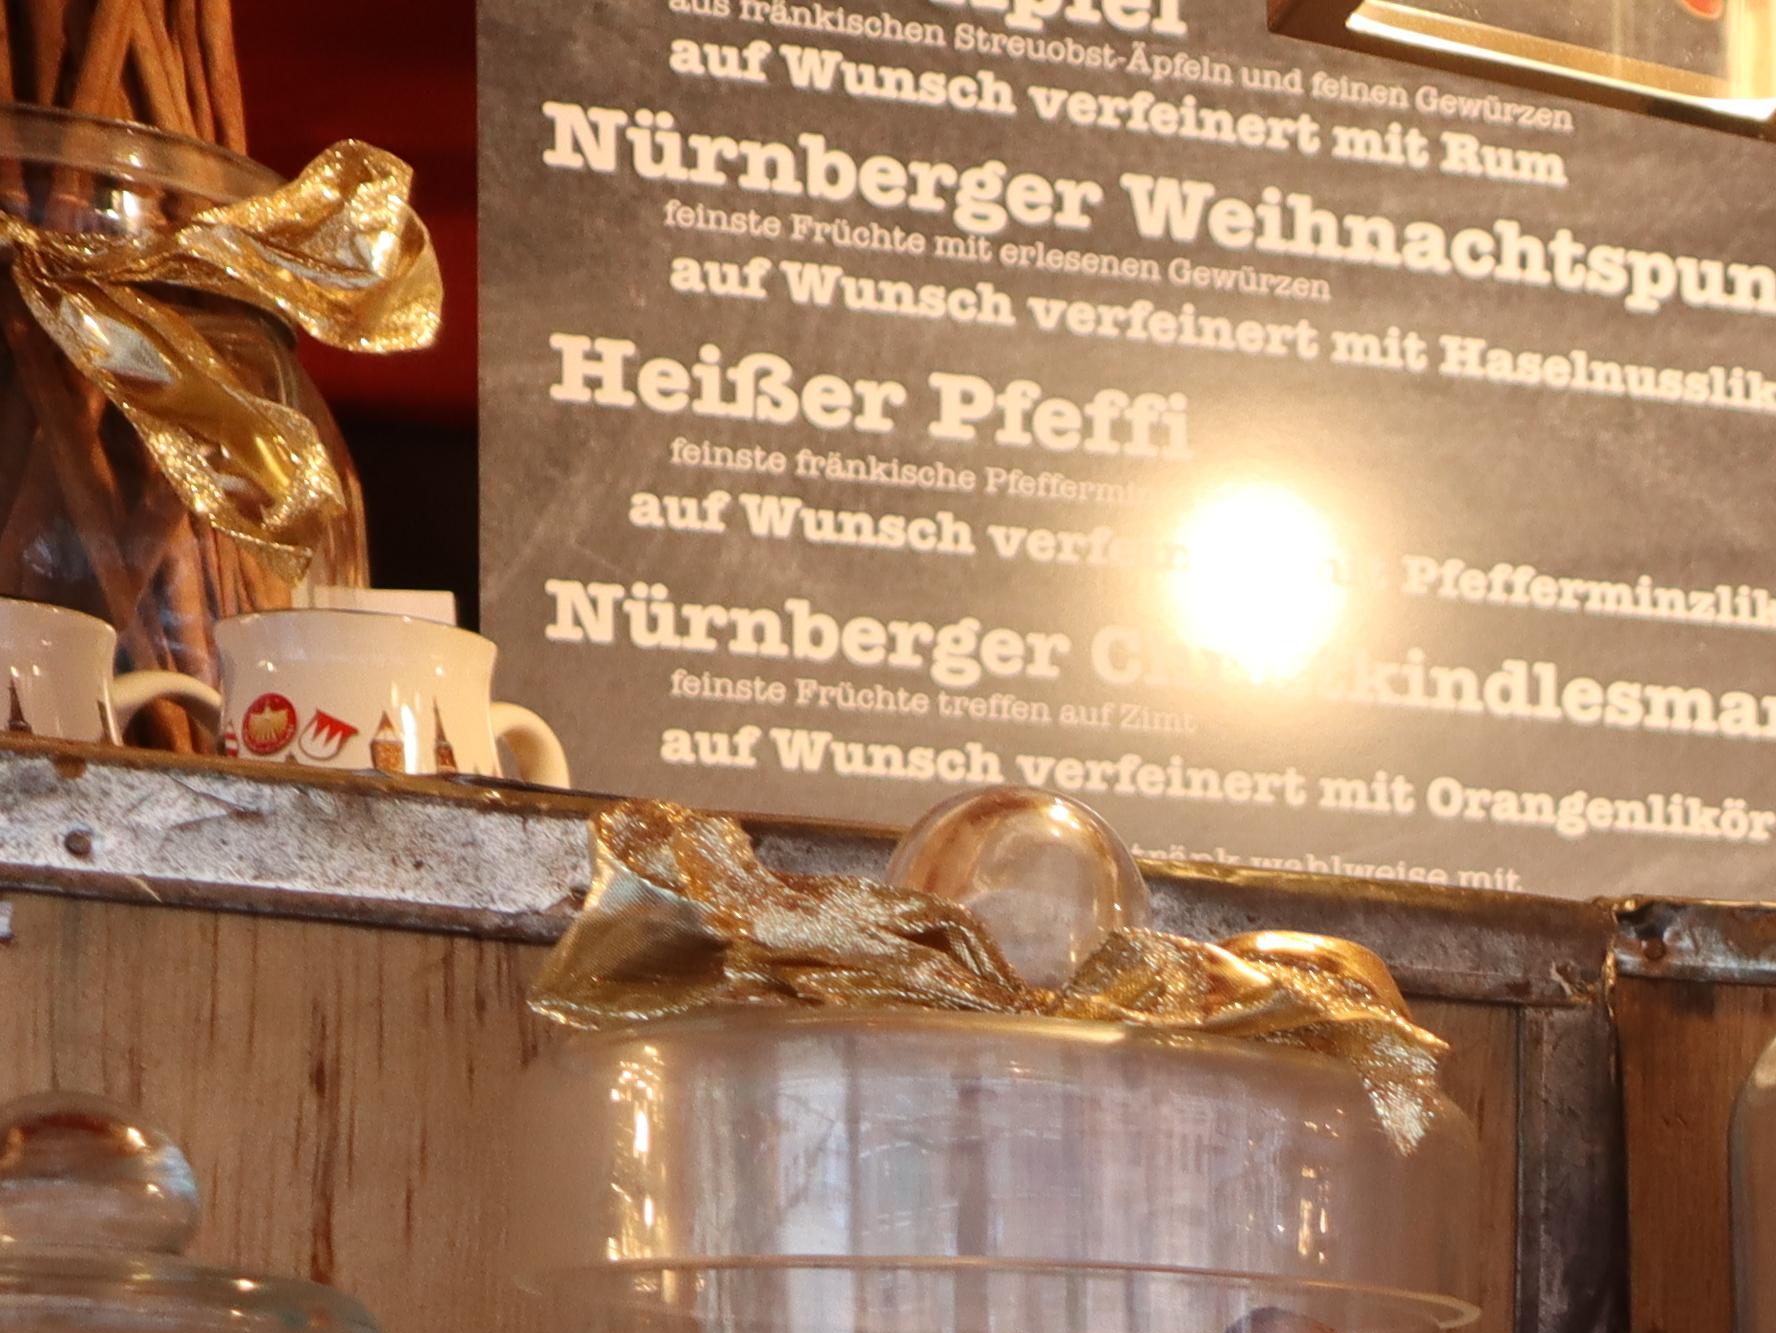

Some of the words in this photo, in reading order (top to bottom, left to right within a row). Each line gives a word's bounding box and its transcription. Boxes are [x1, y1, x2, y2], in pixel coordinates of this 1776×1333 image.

[670, 39, 771, 83] auf
[780, 44, 1016, 116] Wunsch
[1028, 86, 1321, 155] verfeinert
[1332, 122, 1429, 169] mit
[1440, 131, 1568, 186] Rum
[955, 23, 1233, 87] Streuobst-Äpfeln
[1240, 66, 1304, 96] und
[1312, 71, 1409, 110] feinen
[1416, 85, 1574, 134] Gewürzen
[543, 101, 1103, 248] Nürnberger
[665, 199, 781, 239] feinste
[791, 213, 925, 255] Früchte
[935, 228, 998, 263] mit
[1000, 241, 1161, 283] erlesenen
[1168, 258, 1331, 303] Gewürzen
[670, 257, 772, 299] auf
[780, 260, 1016, 327] Wunsch
[1027, 297, 1319, 360] verfeinert
[1331, 326, 1427, 373] mit
[550, 333, 906, 434] Heißer
[928, 372, 1199, 466] Pfeffi
[630, 487, 725, 531] auf
[740, 489, 976, 555] Wunsch
[671, 436, 786, 475] feinste
[796, 448, 976, 492] fränkische
[546, 580, 1071, 699] Nürnberger
[661, 724, 762, 768] auf
[770, 727, 1005, 787] Wunsch
[1015, 753, 1307, 807] verfeinert
[1319, 769, 1415, 815] mit
[1427, 777, 1776, 842] Orangenlikör
